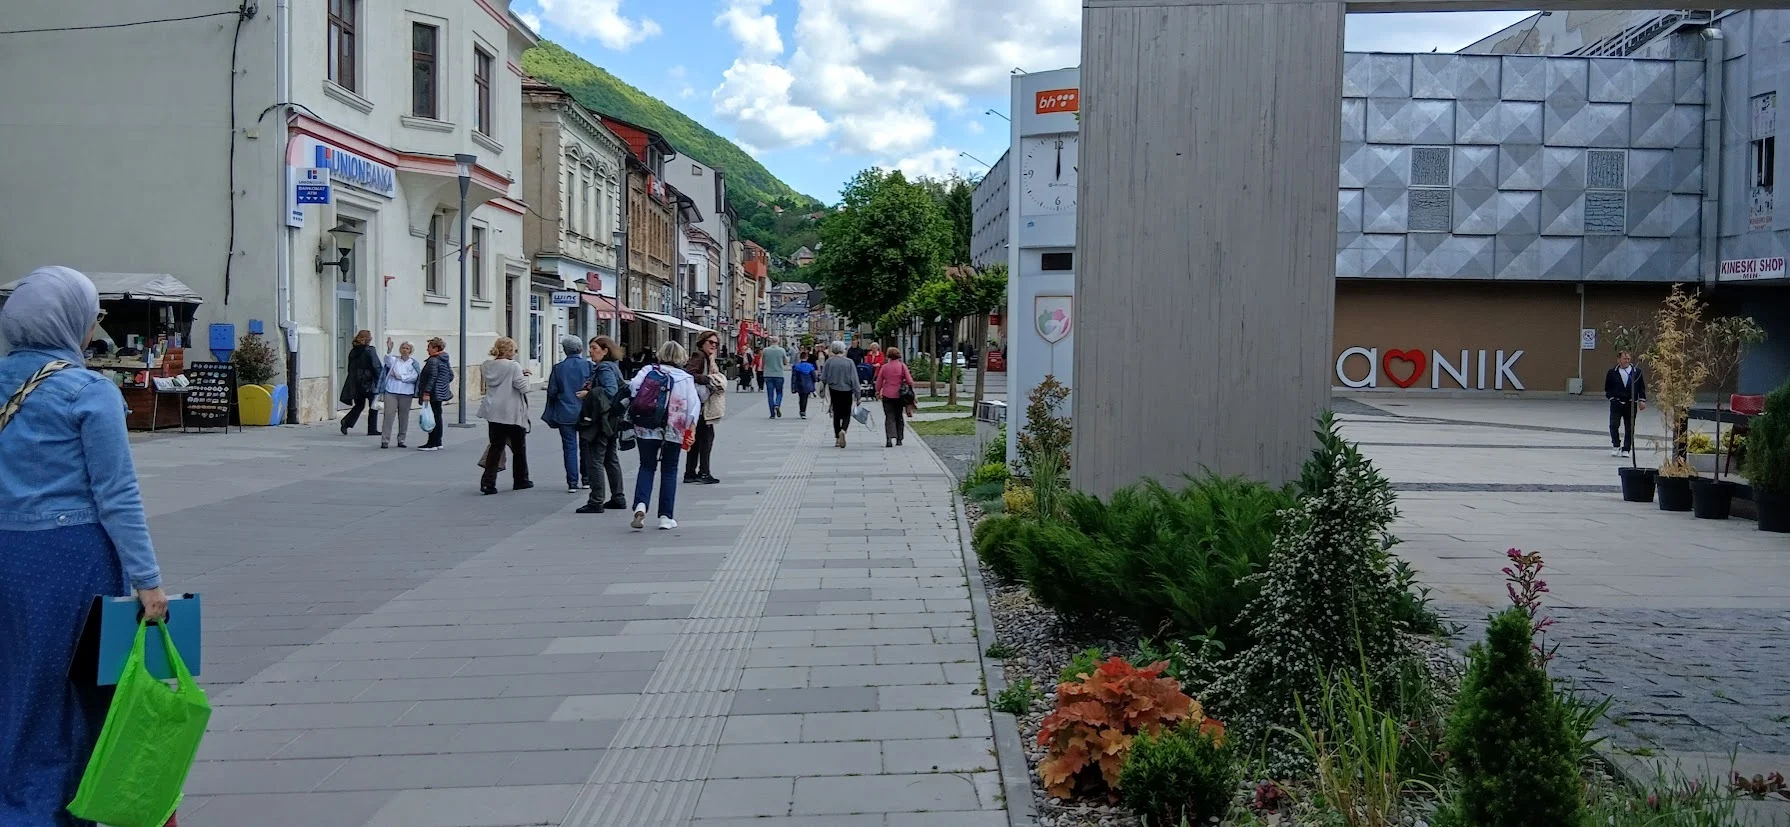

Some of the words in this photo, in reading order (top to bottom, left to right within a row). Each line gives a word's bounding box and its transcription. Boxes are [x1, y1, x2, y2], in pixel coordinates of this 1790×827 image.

[1054, 140, 1064, 149] 12
[332, 149, 393, 191] UNIONBANKA
[1028, 169, 1034, 178] 9
[1055, 196, 1061, 205] 6
[1721, 260, 1757, 275] KINESKI
[1760, 258, 1784, 272] SHOP
[1431, 349, 1525, 390] NIK
